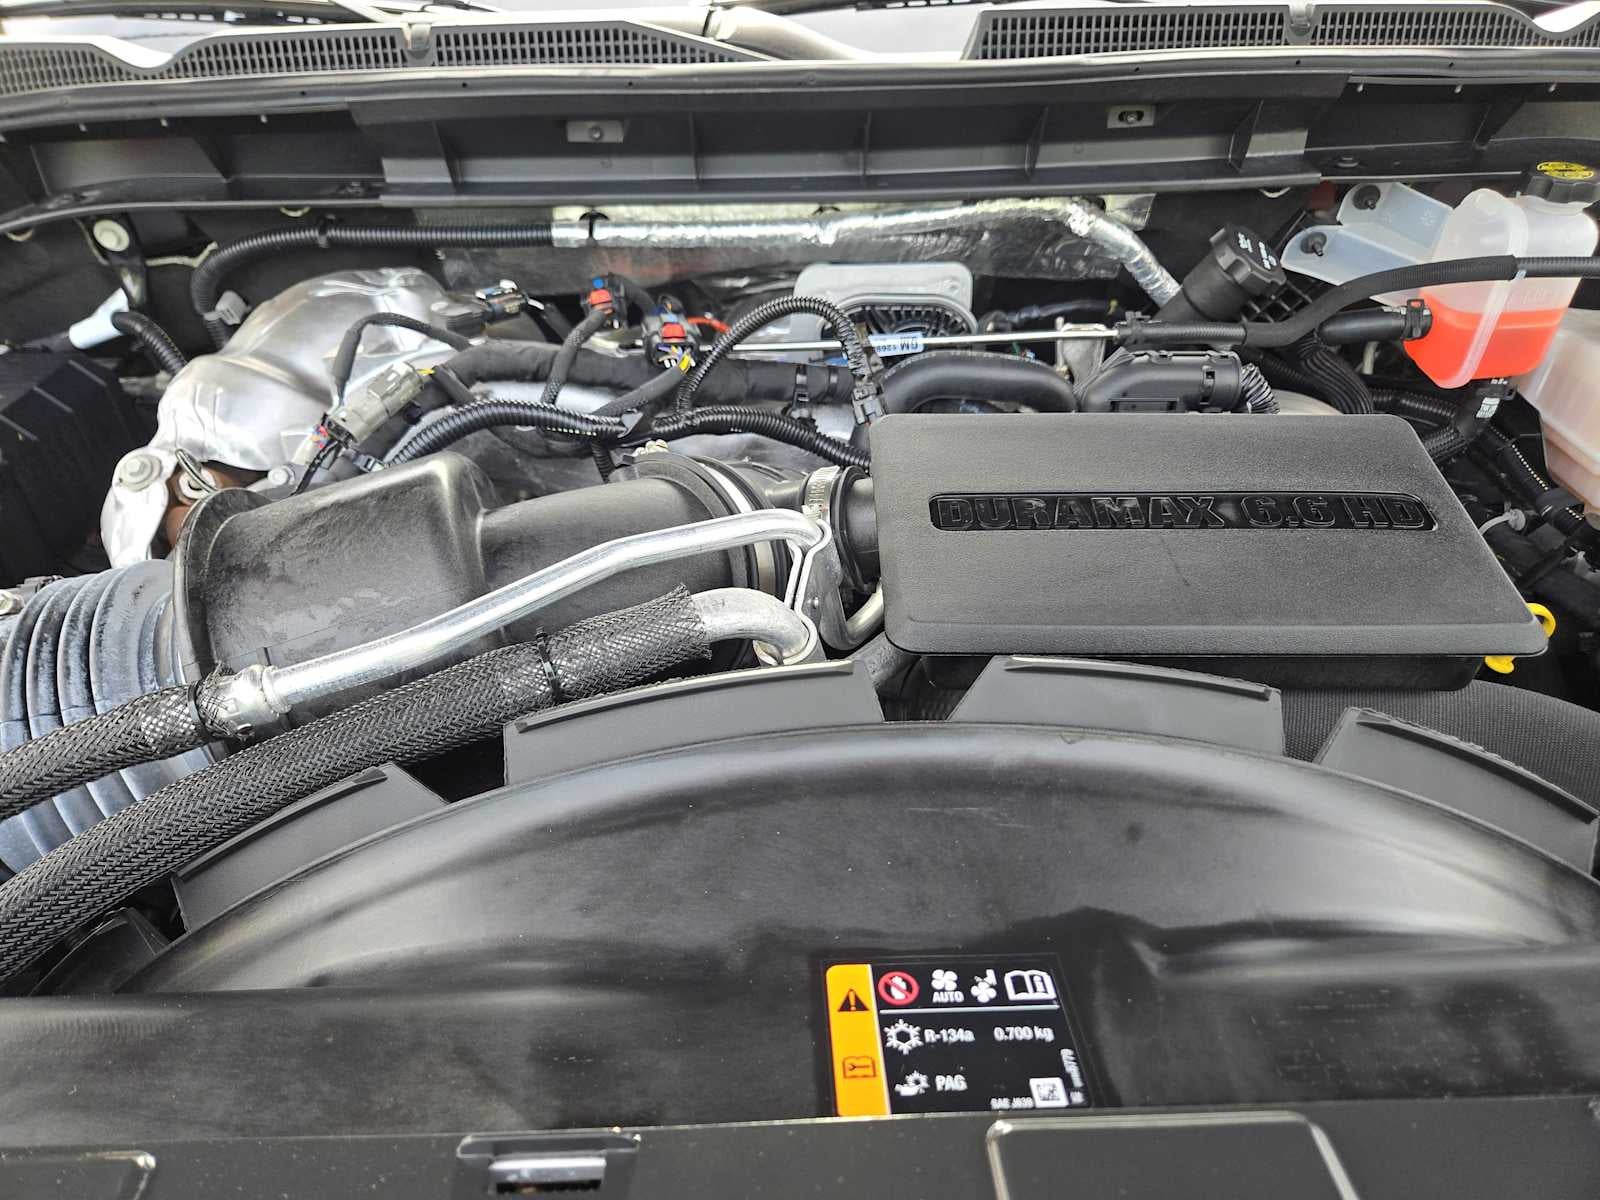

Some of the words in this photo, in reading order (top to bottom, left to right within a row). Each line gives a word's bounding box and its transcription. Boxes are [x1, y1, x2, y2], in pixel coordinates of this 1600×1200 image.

[936, 496, 1225, 529] DURAMAX
[1246, 495, 1336, 528] 6.6
[1350, 495, 1426, 529] HD
[932, 991, 965, 1003] AUTO
[924, 1028, 976, 1043] R-134a
[993, 1026, 1033, 1042] 0.700
[1033, 1025, 1055, 1043] kg
[935, 1074, 968, 1092] PAG
